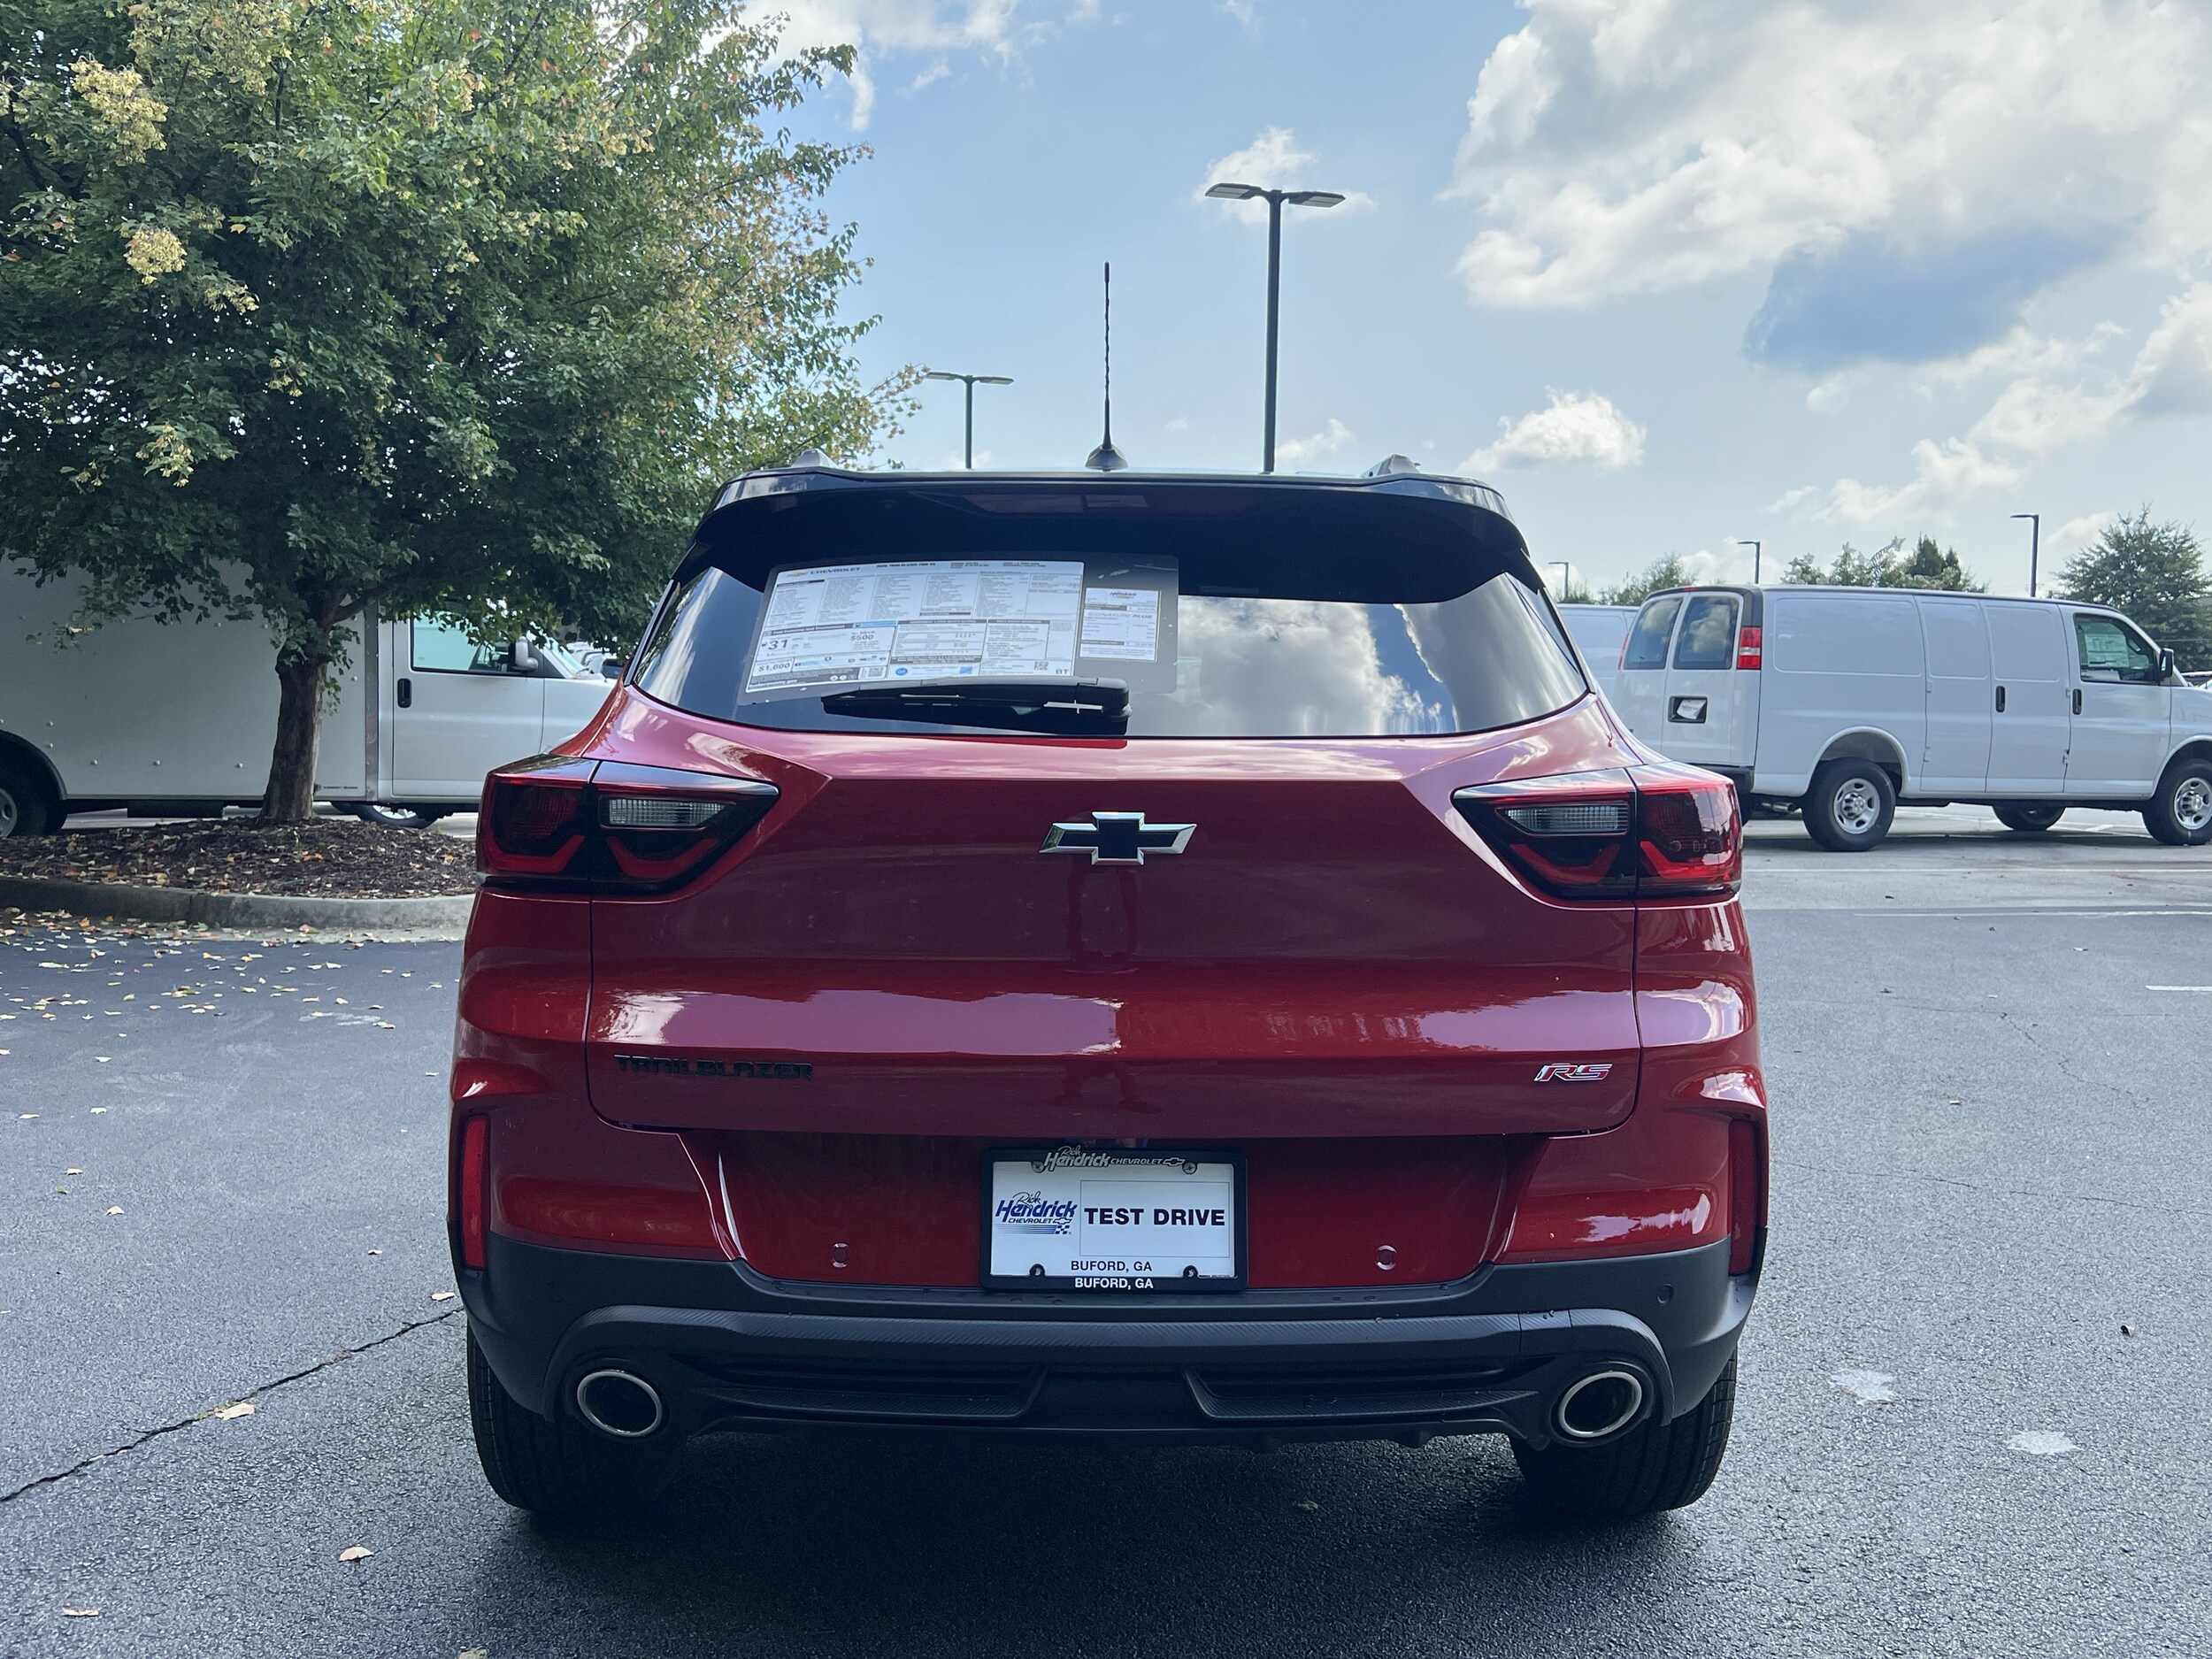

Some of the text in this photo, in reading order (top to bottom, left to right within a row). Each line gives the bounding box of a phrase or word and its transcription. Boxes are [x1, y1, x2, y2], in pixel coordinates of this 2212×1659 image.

[768, 639, 788, 650] 31
[758, 663, 790, 672] $1,600
[614, 1054, 813, 1079] TRAILBLAZER
[1533, 1063, 1613, 1082] RS
[1057, 1145, 1081, 1157] Rick
[1043, 1151, 1110, 1171] Hendrick
[1012, 1191, 1041, 1209] Rick
[995, 1200, 1078, 1223] Hendrick
[1084, 1208, 1225, 1226] TEST DRIVE
[1071, 1261, 1152, 1273] BUFORD, GA
[1074, 1278, 1154, 1290] BUFORD, GA
